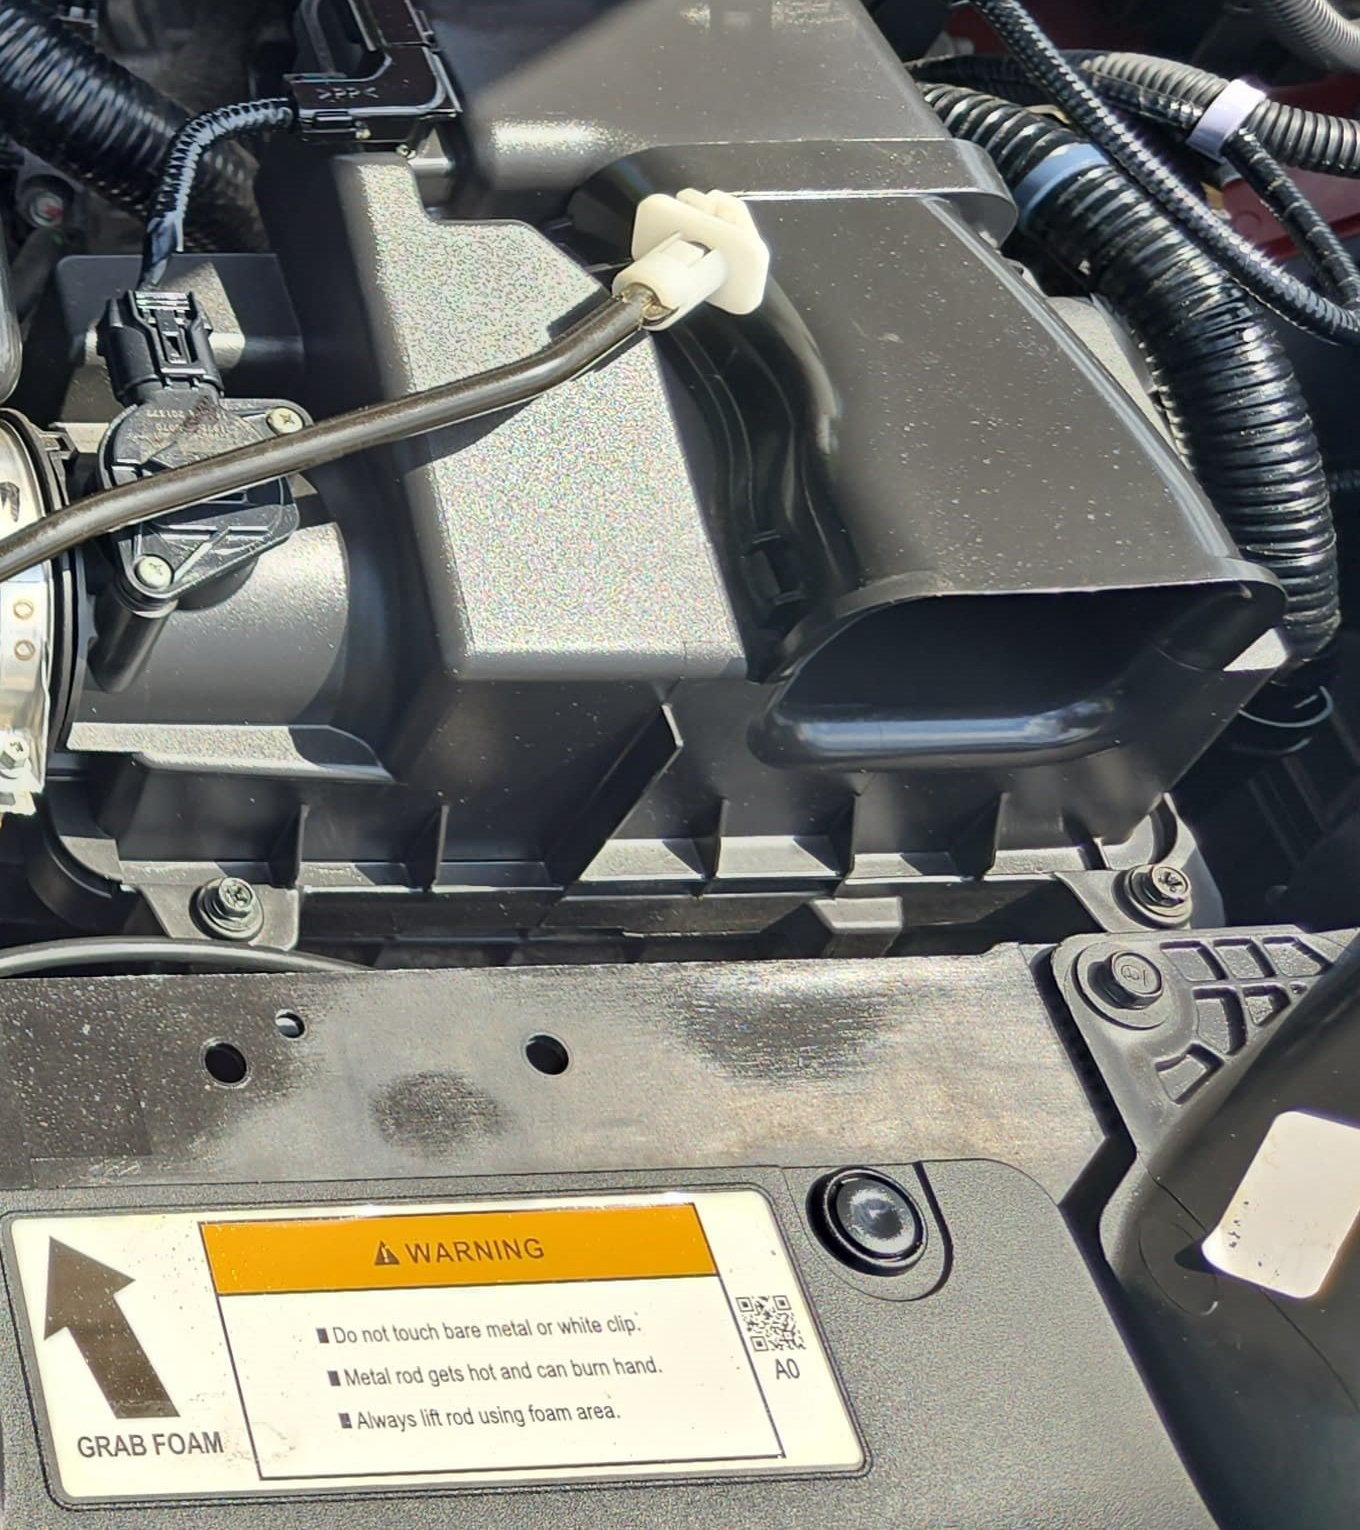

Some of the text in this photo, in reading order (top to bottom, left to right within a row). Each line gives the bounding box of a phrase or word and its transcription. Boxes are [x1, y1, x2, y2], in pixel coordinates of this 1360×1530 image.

[404, 1238, 545, 1265] WARNING
[332, 1315, 642, 1344] Do not touch bare metal or white clip.
[343, 1355, 663, 1387] Metal rod gets hot and can burn hand.
[775, 1357, 801, 1381] A0
[356, 1404, 621, 1432] Always lift rod using foam area.
[77, 1431, 225, 1459] GRAB FOAM
